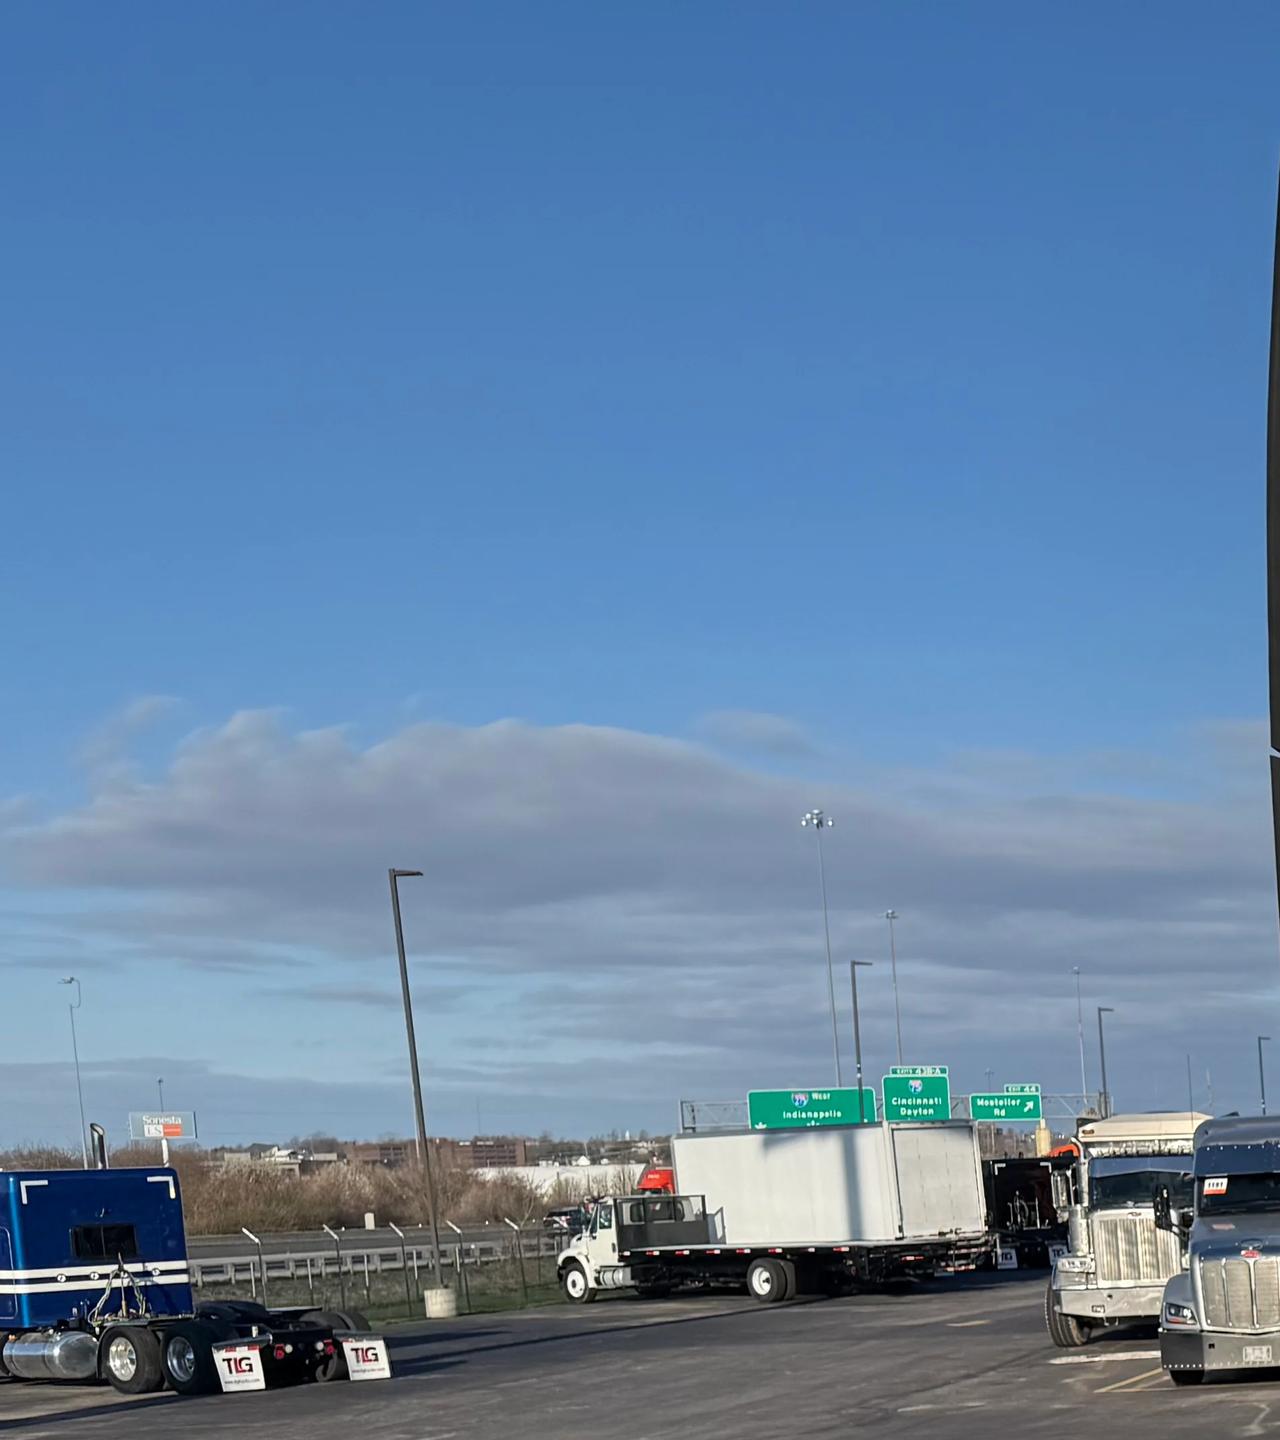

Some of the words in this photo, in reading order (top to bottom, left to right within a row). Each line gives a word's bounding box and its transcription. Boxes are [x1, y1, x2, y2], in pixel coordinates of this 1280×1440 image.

[891, 1097, 942, 1106] Cincinnati
[783, 1109, 842, 1120] Indianapolis
[900, 1107, 934, 1117] Dayton
[994, 1108, 1006, 1117] Rd
[142, 1114, 182, 1125] Sonesta
[350, 1346, 379, 1363] TLG
[222, 1356, 254, 1374] TLG
